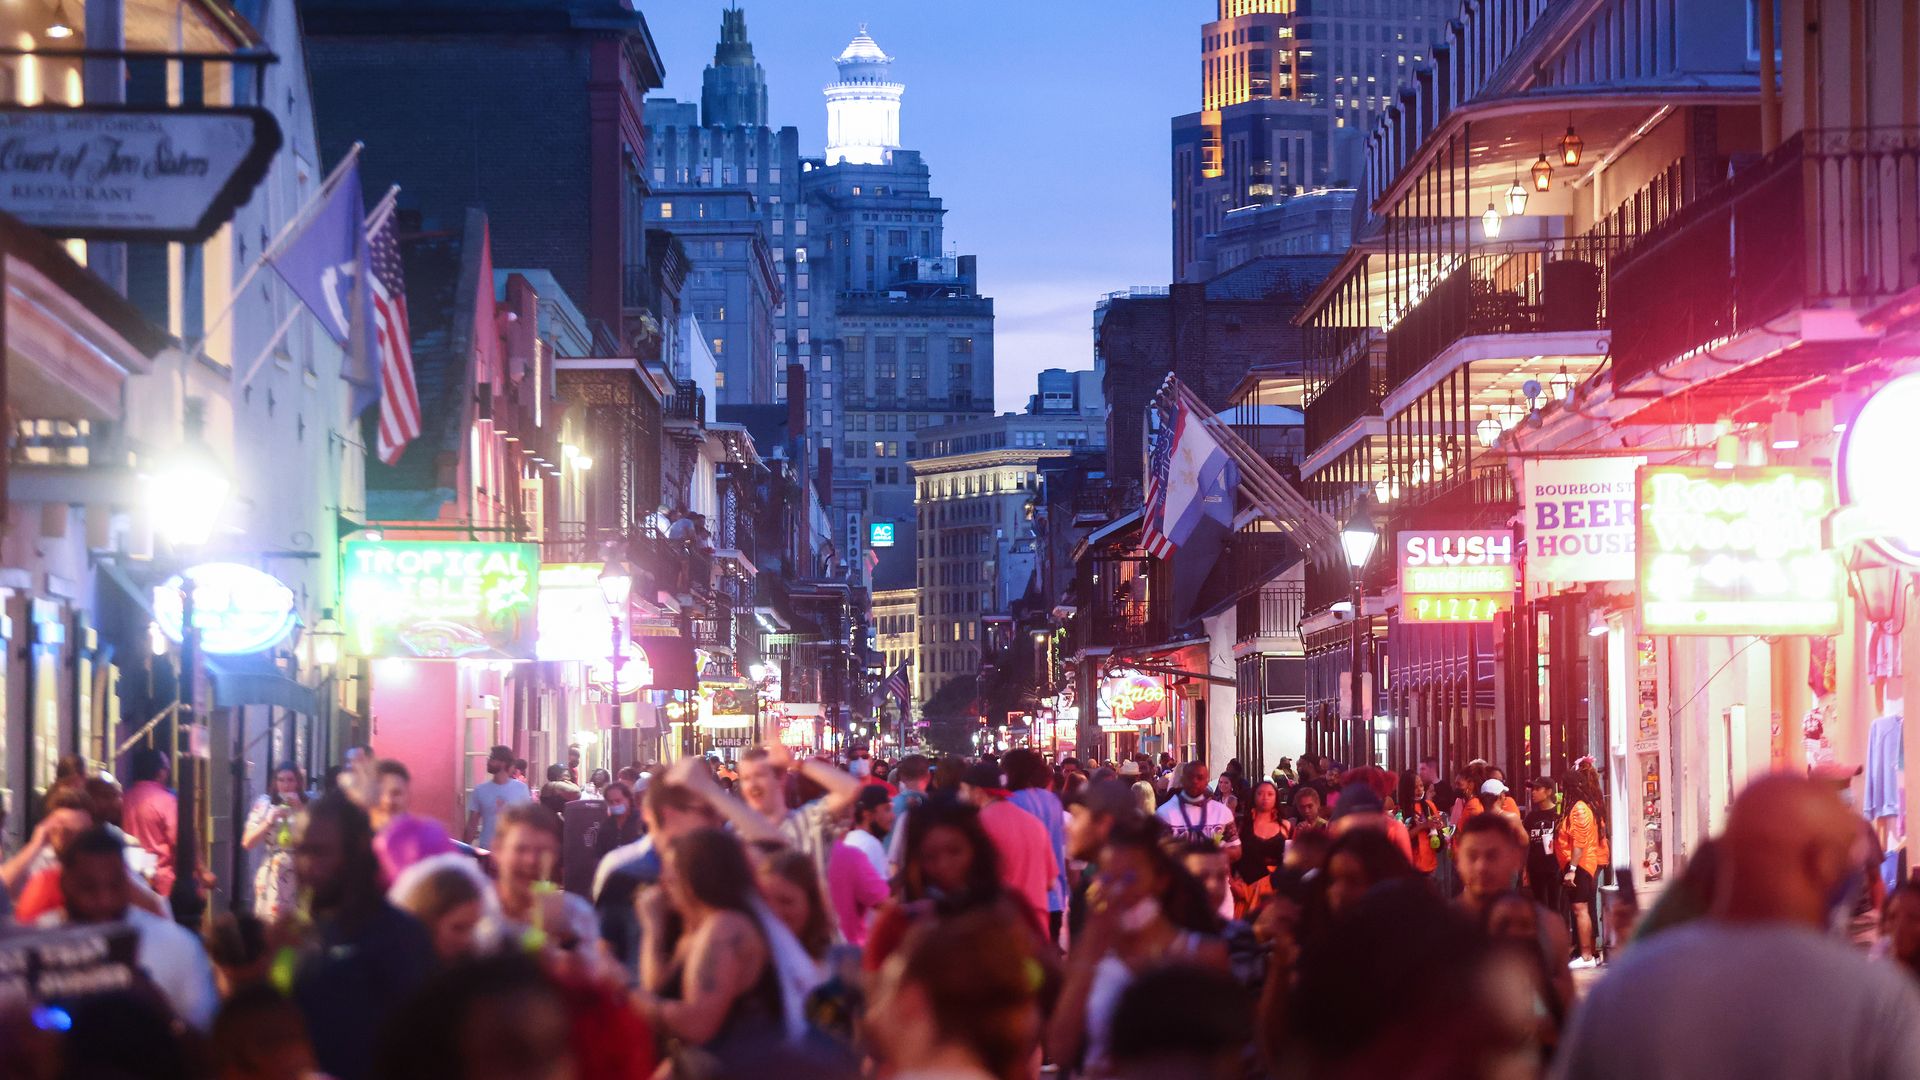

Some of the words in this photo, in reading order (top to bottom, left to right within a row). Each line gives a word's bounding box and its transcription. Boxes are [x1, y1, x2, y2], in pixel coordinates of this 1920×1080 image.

[11, 184, 135, 201] RESTAURANT
[1535, 482, 1611, 497] BOURBON
[1535, 499, 1635, 530] BEER
[873, 525, 892, 536] AC
[1407, 536, 1511, 565] SLUSH
[1536, 533, 1635, 557] HOUSE
[354, 549, 528, 577] TROPICAL
[397, 576, 483, 601] ISLE
[1418, 598, 1497, 620] PIZZA
[717, 738, 742, 746] CHRIS
